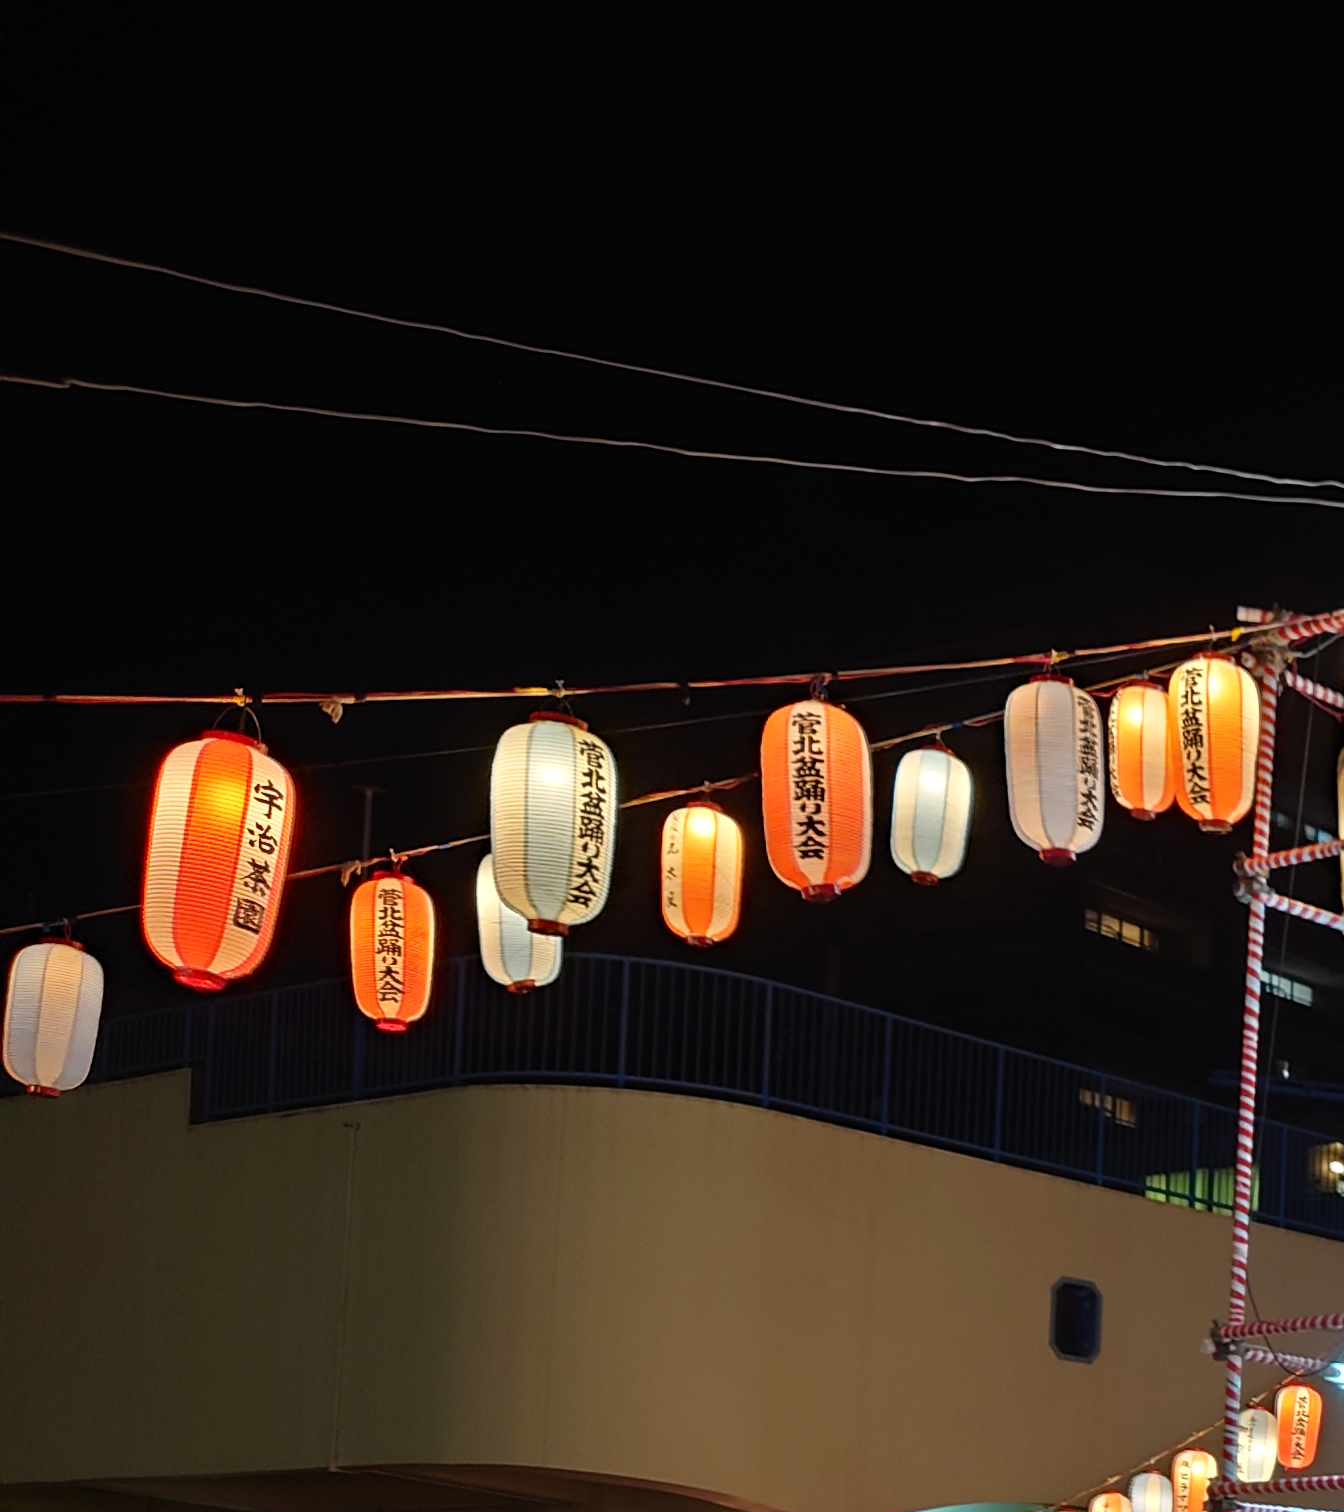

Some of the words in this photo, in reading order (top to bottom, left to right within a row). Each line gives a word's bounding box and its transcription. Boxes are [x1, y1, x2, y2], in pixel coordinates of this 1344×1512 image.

[791, 712, 829, 861] 菅北盆踊り大会
[1180, 667, 1211, 805] 菅北盆踊り大会
[233, 780, 285, 934] 宇治茶園
[569, 740, 606, 909] 菅北盆踊り大会
[378, 888, 403, 1003] 菅北盆踊り大会
